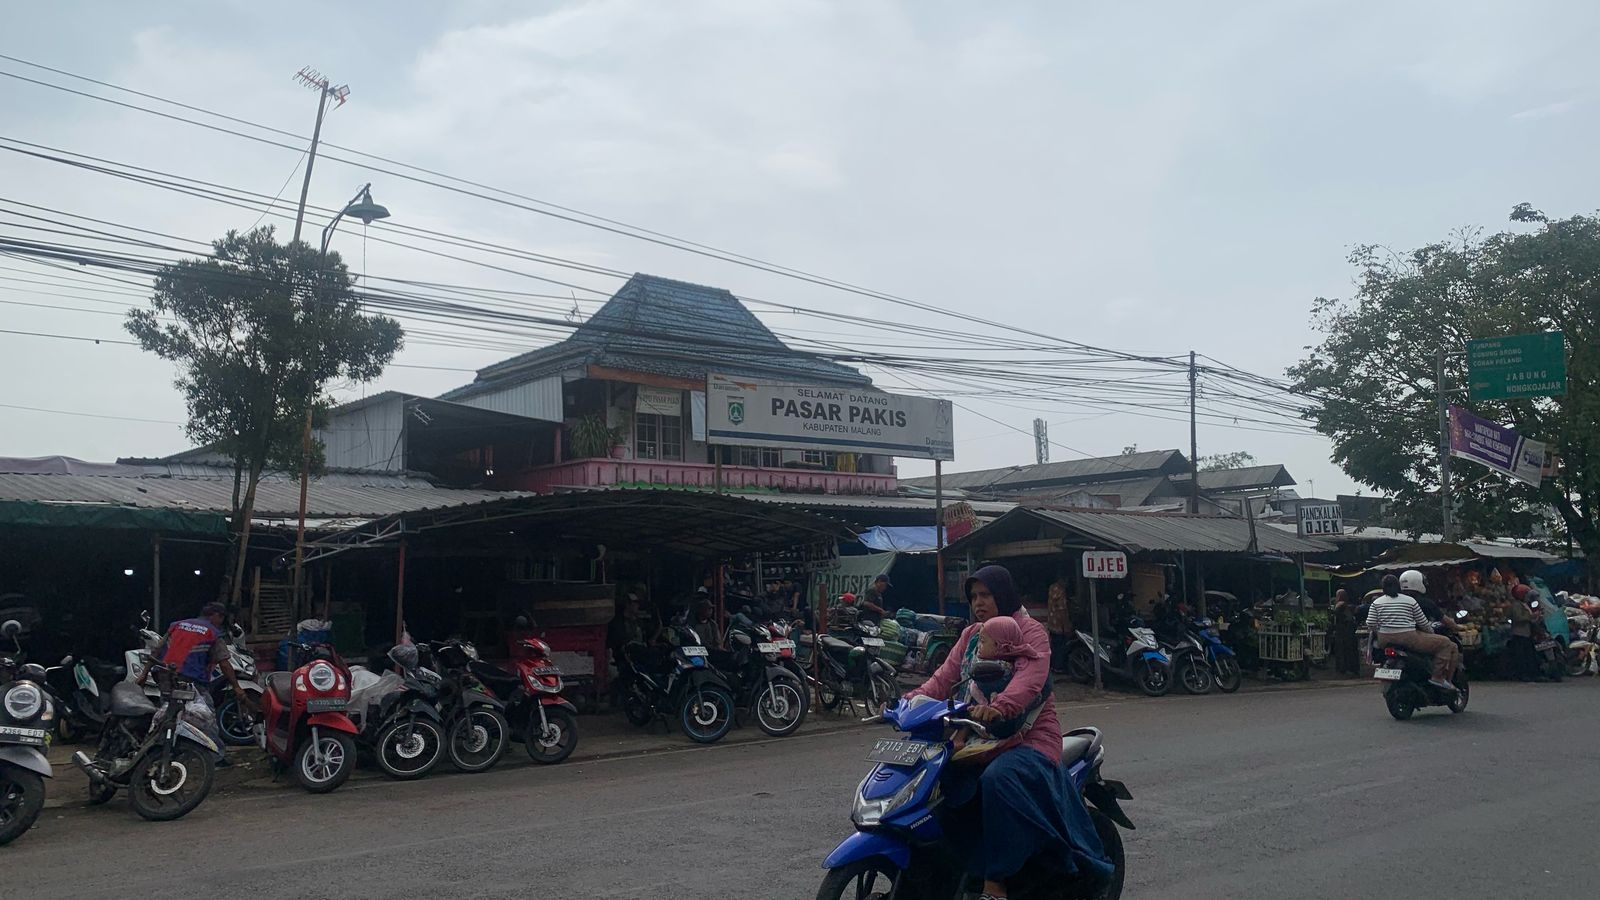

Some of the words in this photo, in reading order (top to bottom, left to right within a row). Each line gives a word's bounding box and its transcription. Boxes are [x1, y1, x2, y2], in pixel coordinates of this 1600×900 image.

[1507, 371, 1547, 381] JABUNG
[1507, 382, 1561, 392] NONGKOJAJAR
[797, 388, 844, 400] SELAMAT
[849, 394, 888, 406] DATANG
[771, 397, 842, 421] PASAR
[849, 405, 907, 427] PAKIS
[803, 423, 849, 433] KABUPATEN
[851, 426, 882, 436] MALANG
[1087, 557, 1124, 572] OJEG
[882, 741, 903, 752] 2113
[907, 743, 925, 753] EBT
[910, 815, 932, 829] HONDA
